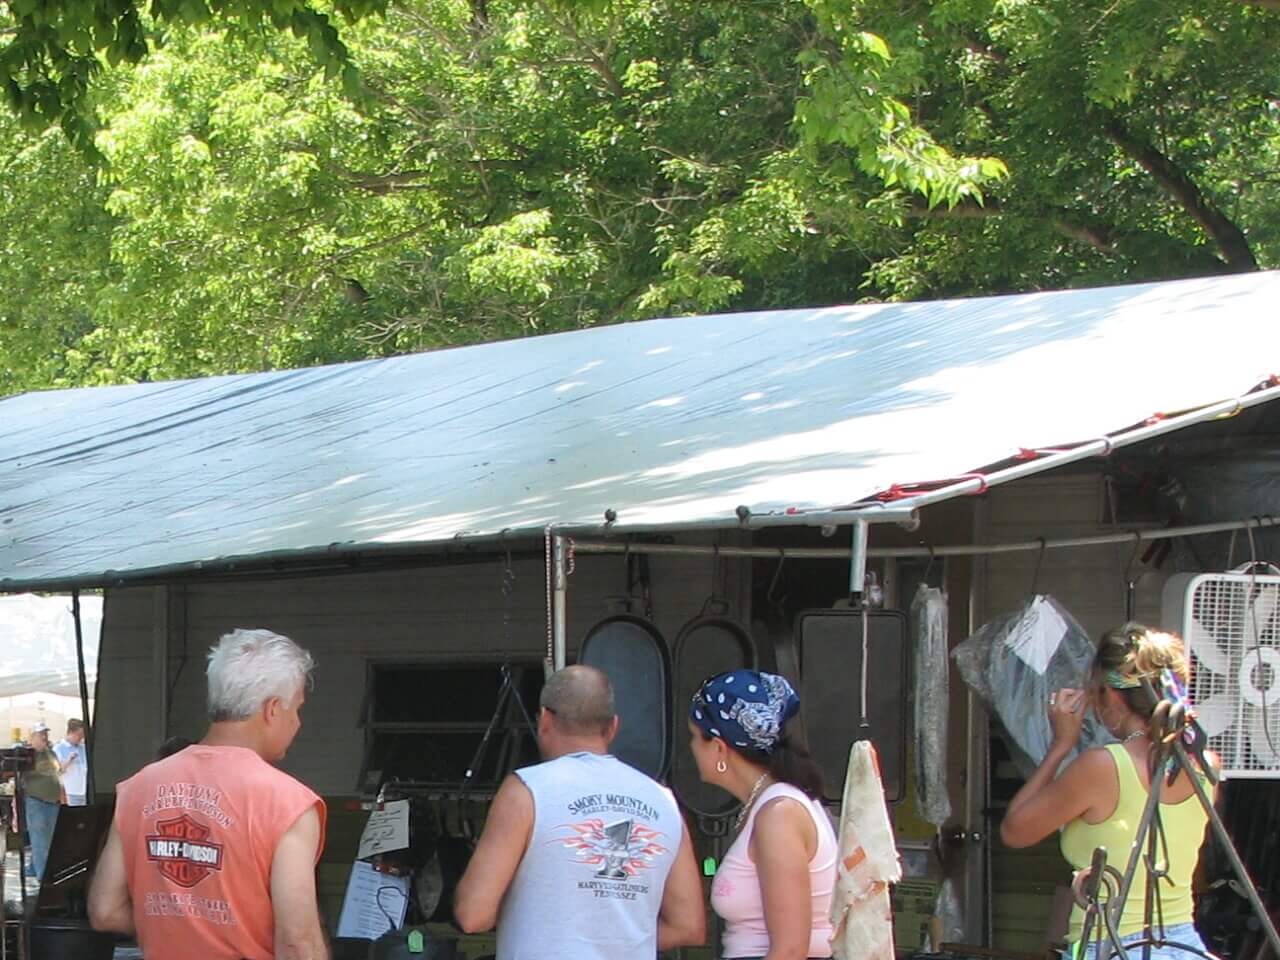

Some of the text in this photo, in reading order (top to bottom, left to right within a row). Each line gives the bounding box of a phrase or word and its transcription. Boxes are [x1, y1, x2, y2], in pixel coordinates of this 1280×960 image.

[157, 783, 222, 807] DAYTONA
[567, 793, 659, 821] SMOKY MOUNTAIN
[592, 889, 637, 901] TENSSEE
